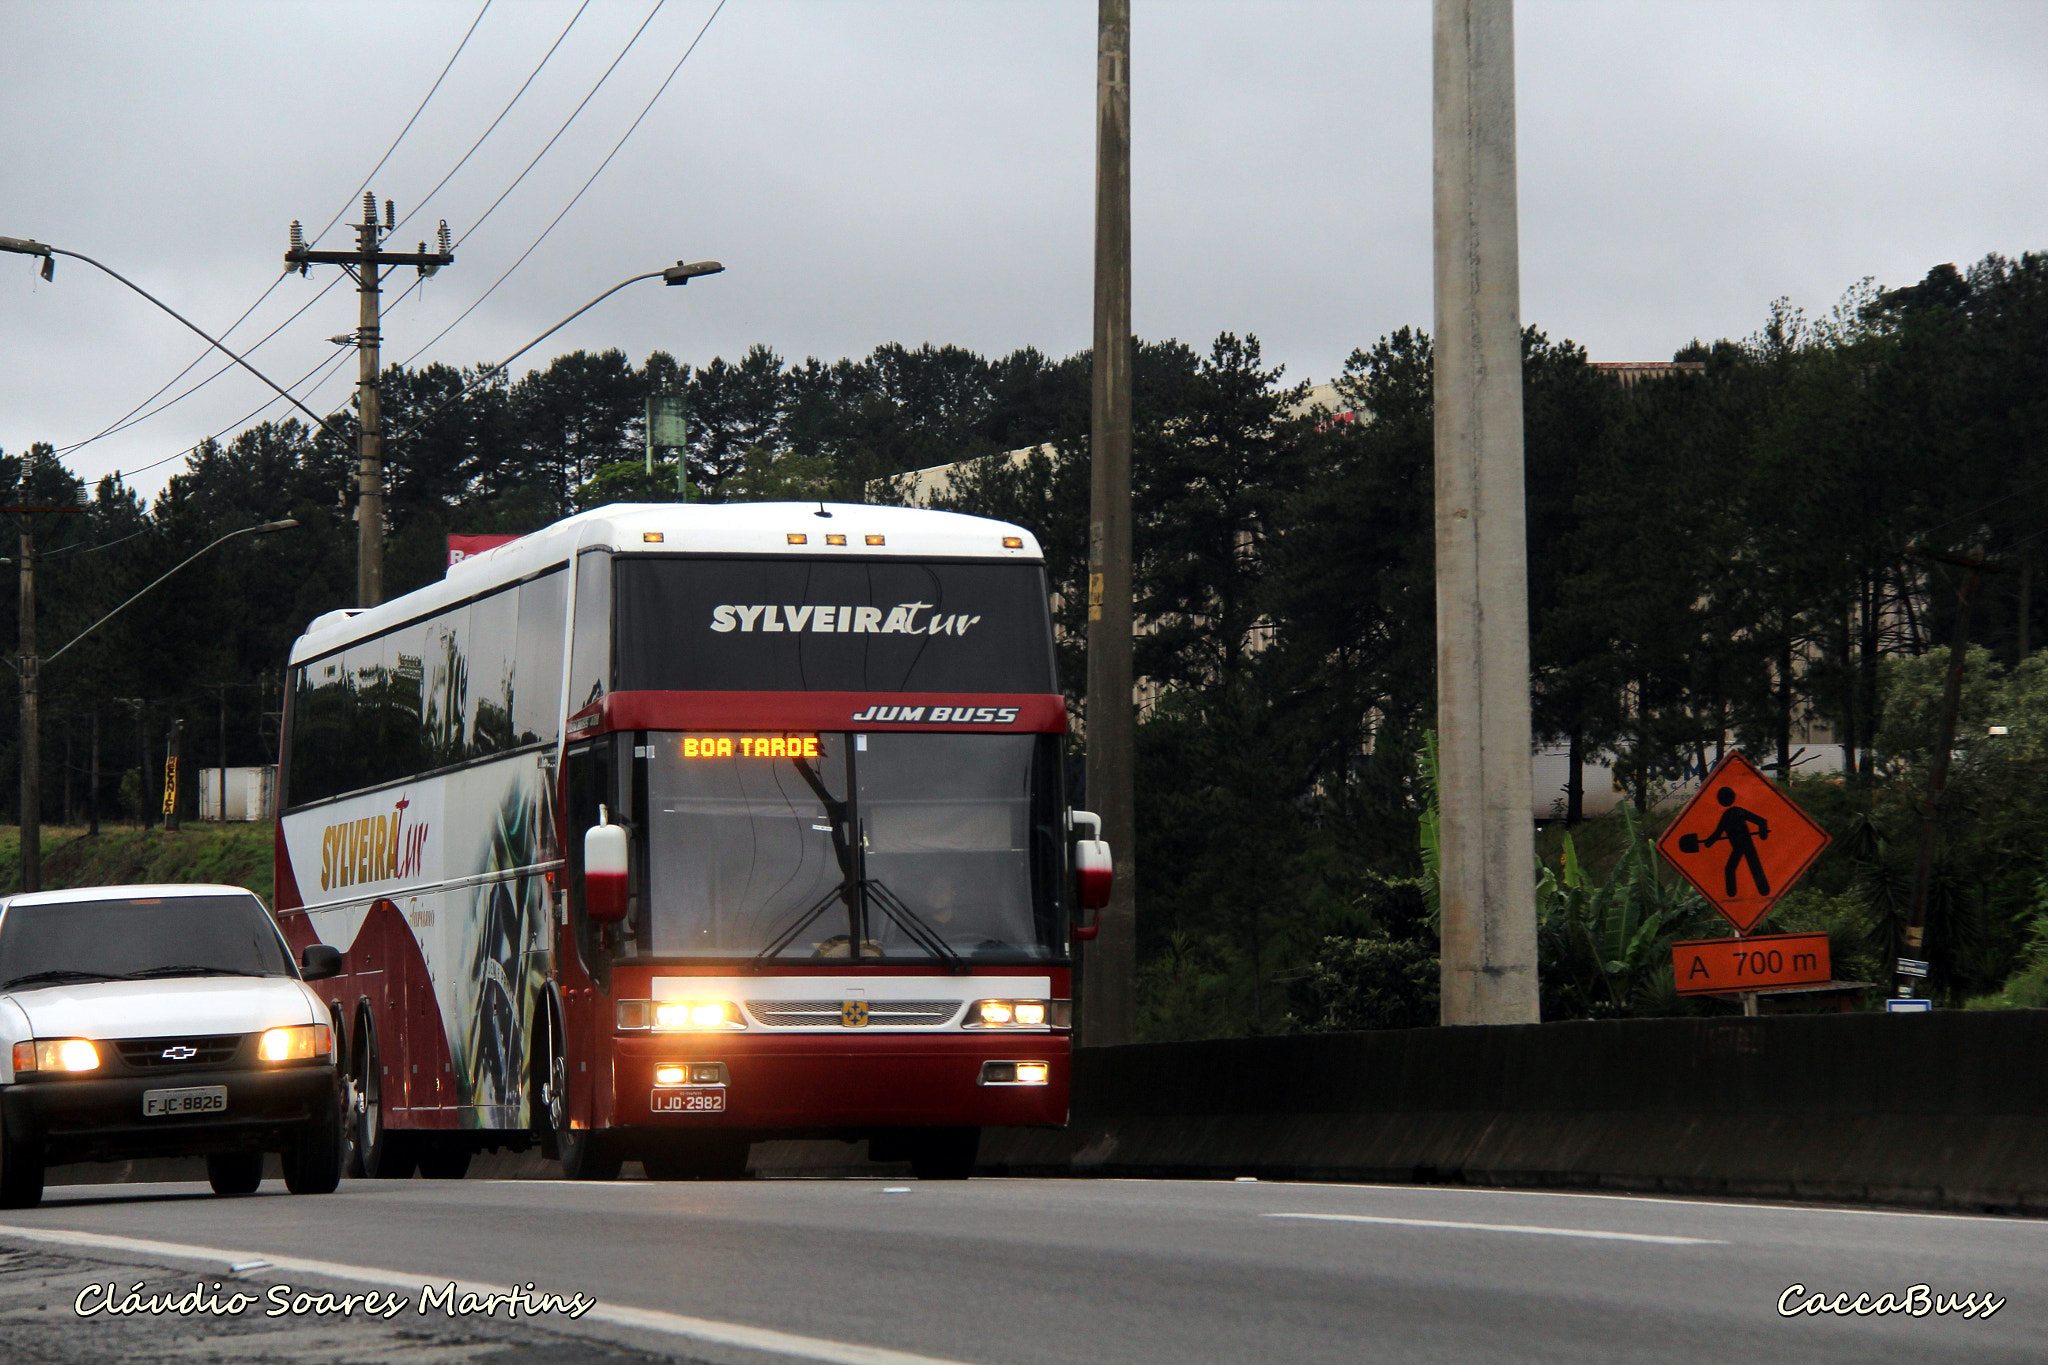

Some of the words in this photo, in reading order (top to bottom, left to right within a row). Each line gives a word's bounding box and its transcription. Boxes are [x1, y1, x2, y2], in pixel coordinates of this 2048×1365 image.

[852, 705, 925, 723] JUM
[928, 706, 1020, 723] BUSS
[683, 737, 732, 758] BOA
[740, 737, 819, 758] TARDE
[1689, 955, 1710, 980] A
[1732, 950, 1783, 977] 700
[1793, 952, 1817, 972] m
